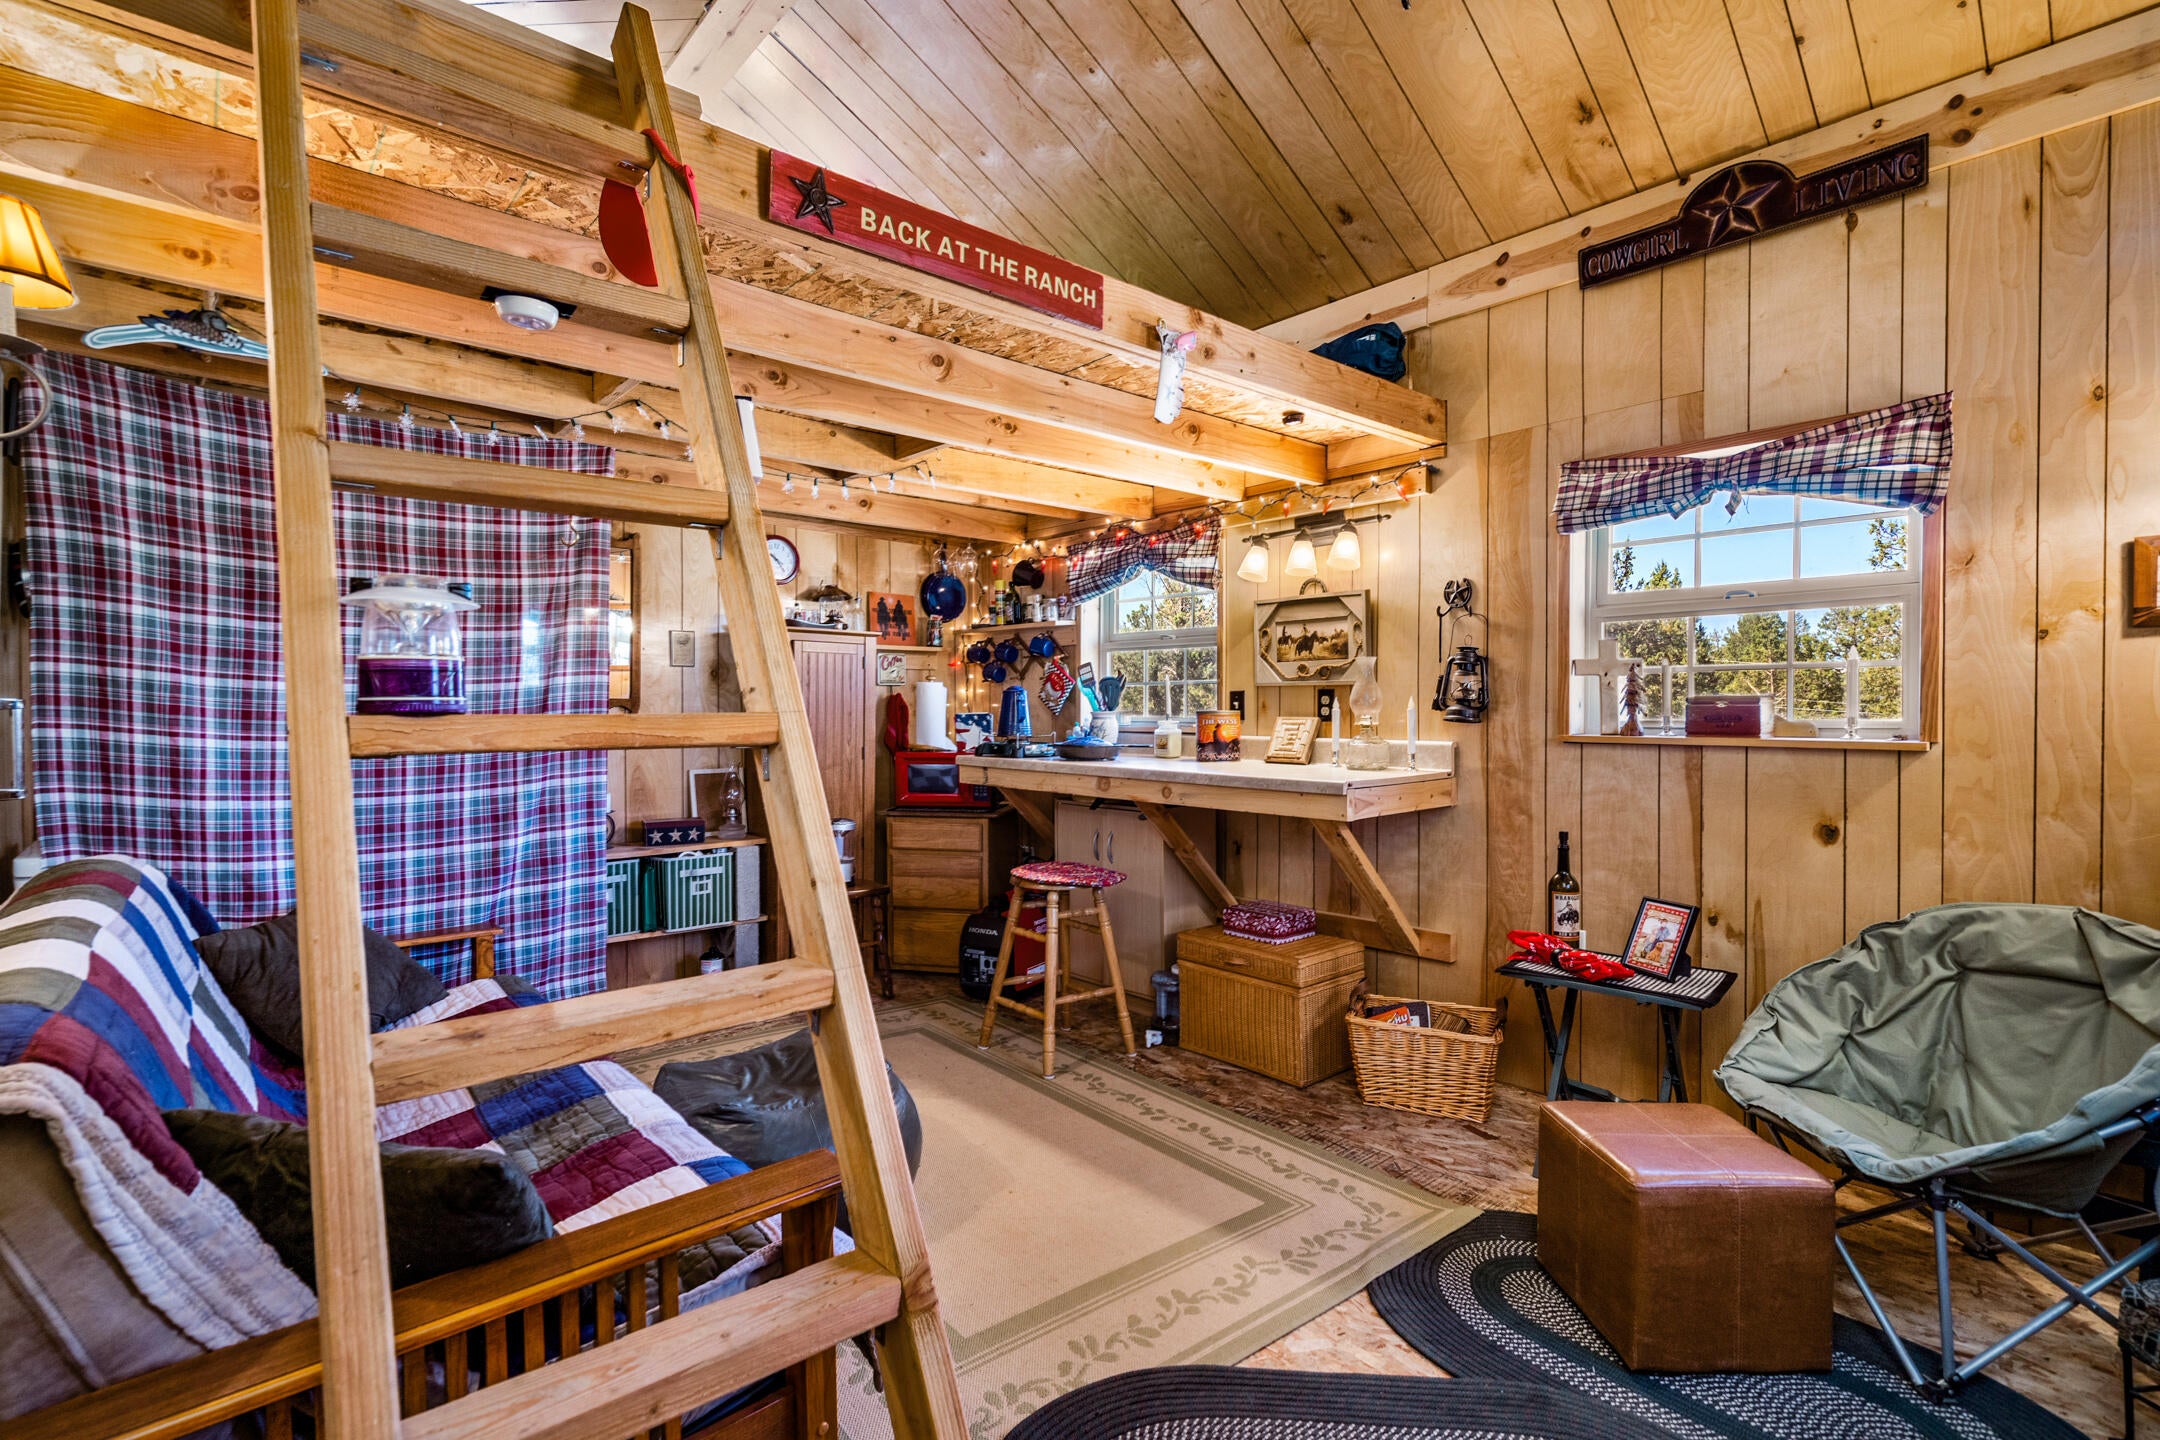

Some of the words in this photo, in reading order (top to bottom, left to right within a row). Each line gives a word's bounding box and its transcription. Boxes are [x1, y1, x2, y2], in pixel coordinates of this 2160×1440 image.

[860, 206, 931, 252] BACK
[937, 235, 969, 263] AT
[975, 247, 1018, 281] THE
[1025, 265, 1097, 308] RANCH
[1585, 226, 1690, 277] COWGIRL
[1792, 152, 1921, 216] LIVING
[968, 927, 998, 936] HONDA
